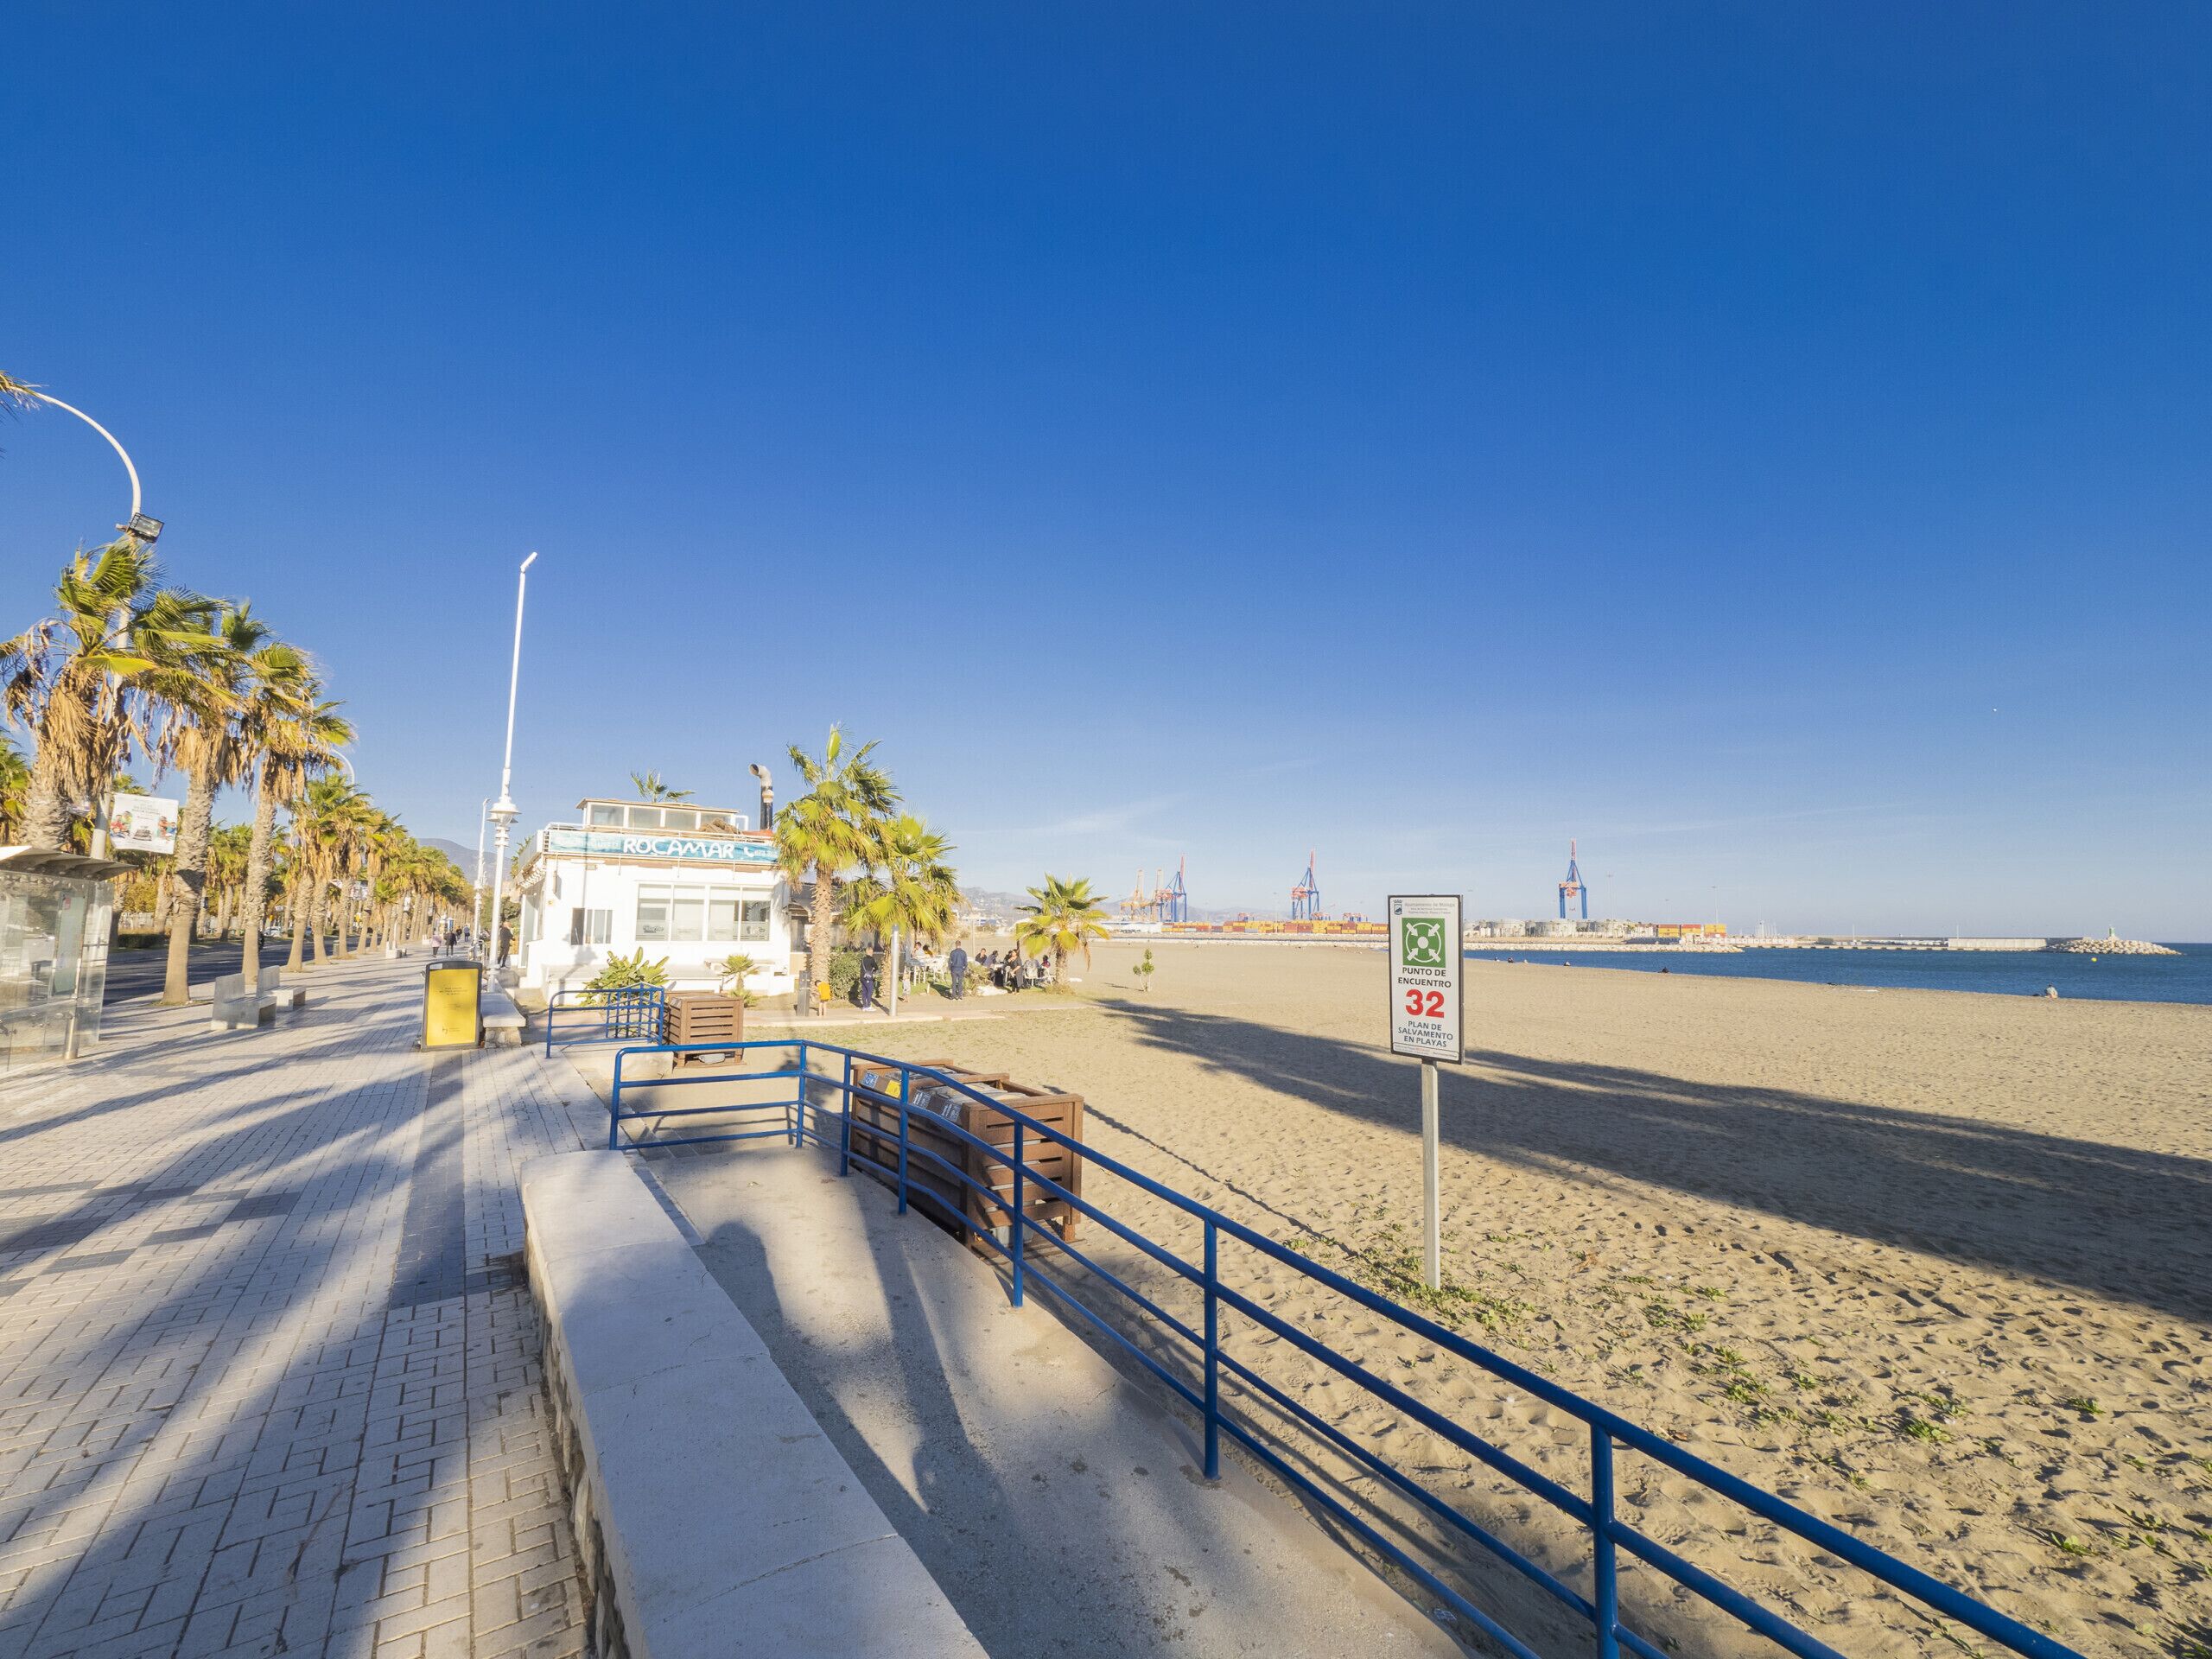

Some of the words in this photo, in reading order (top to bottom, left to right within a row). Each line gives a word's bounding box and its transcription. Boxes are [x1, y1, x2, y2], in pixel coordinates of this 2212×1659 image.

[623, 837, 734, 859] ROCAMAR
[1402, 967, 1432, 976] PUNTO
[1398, 977, 1452, 988] ENCUENTRO
[1406, 988, 1445, 1018] 32
[1408, 1020, 1429, 1029] PLAN
[1398, 1027, 1453, 1040] SALVAMENTO
[1416, 1037, 1446, 1047] PLAYAS
